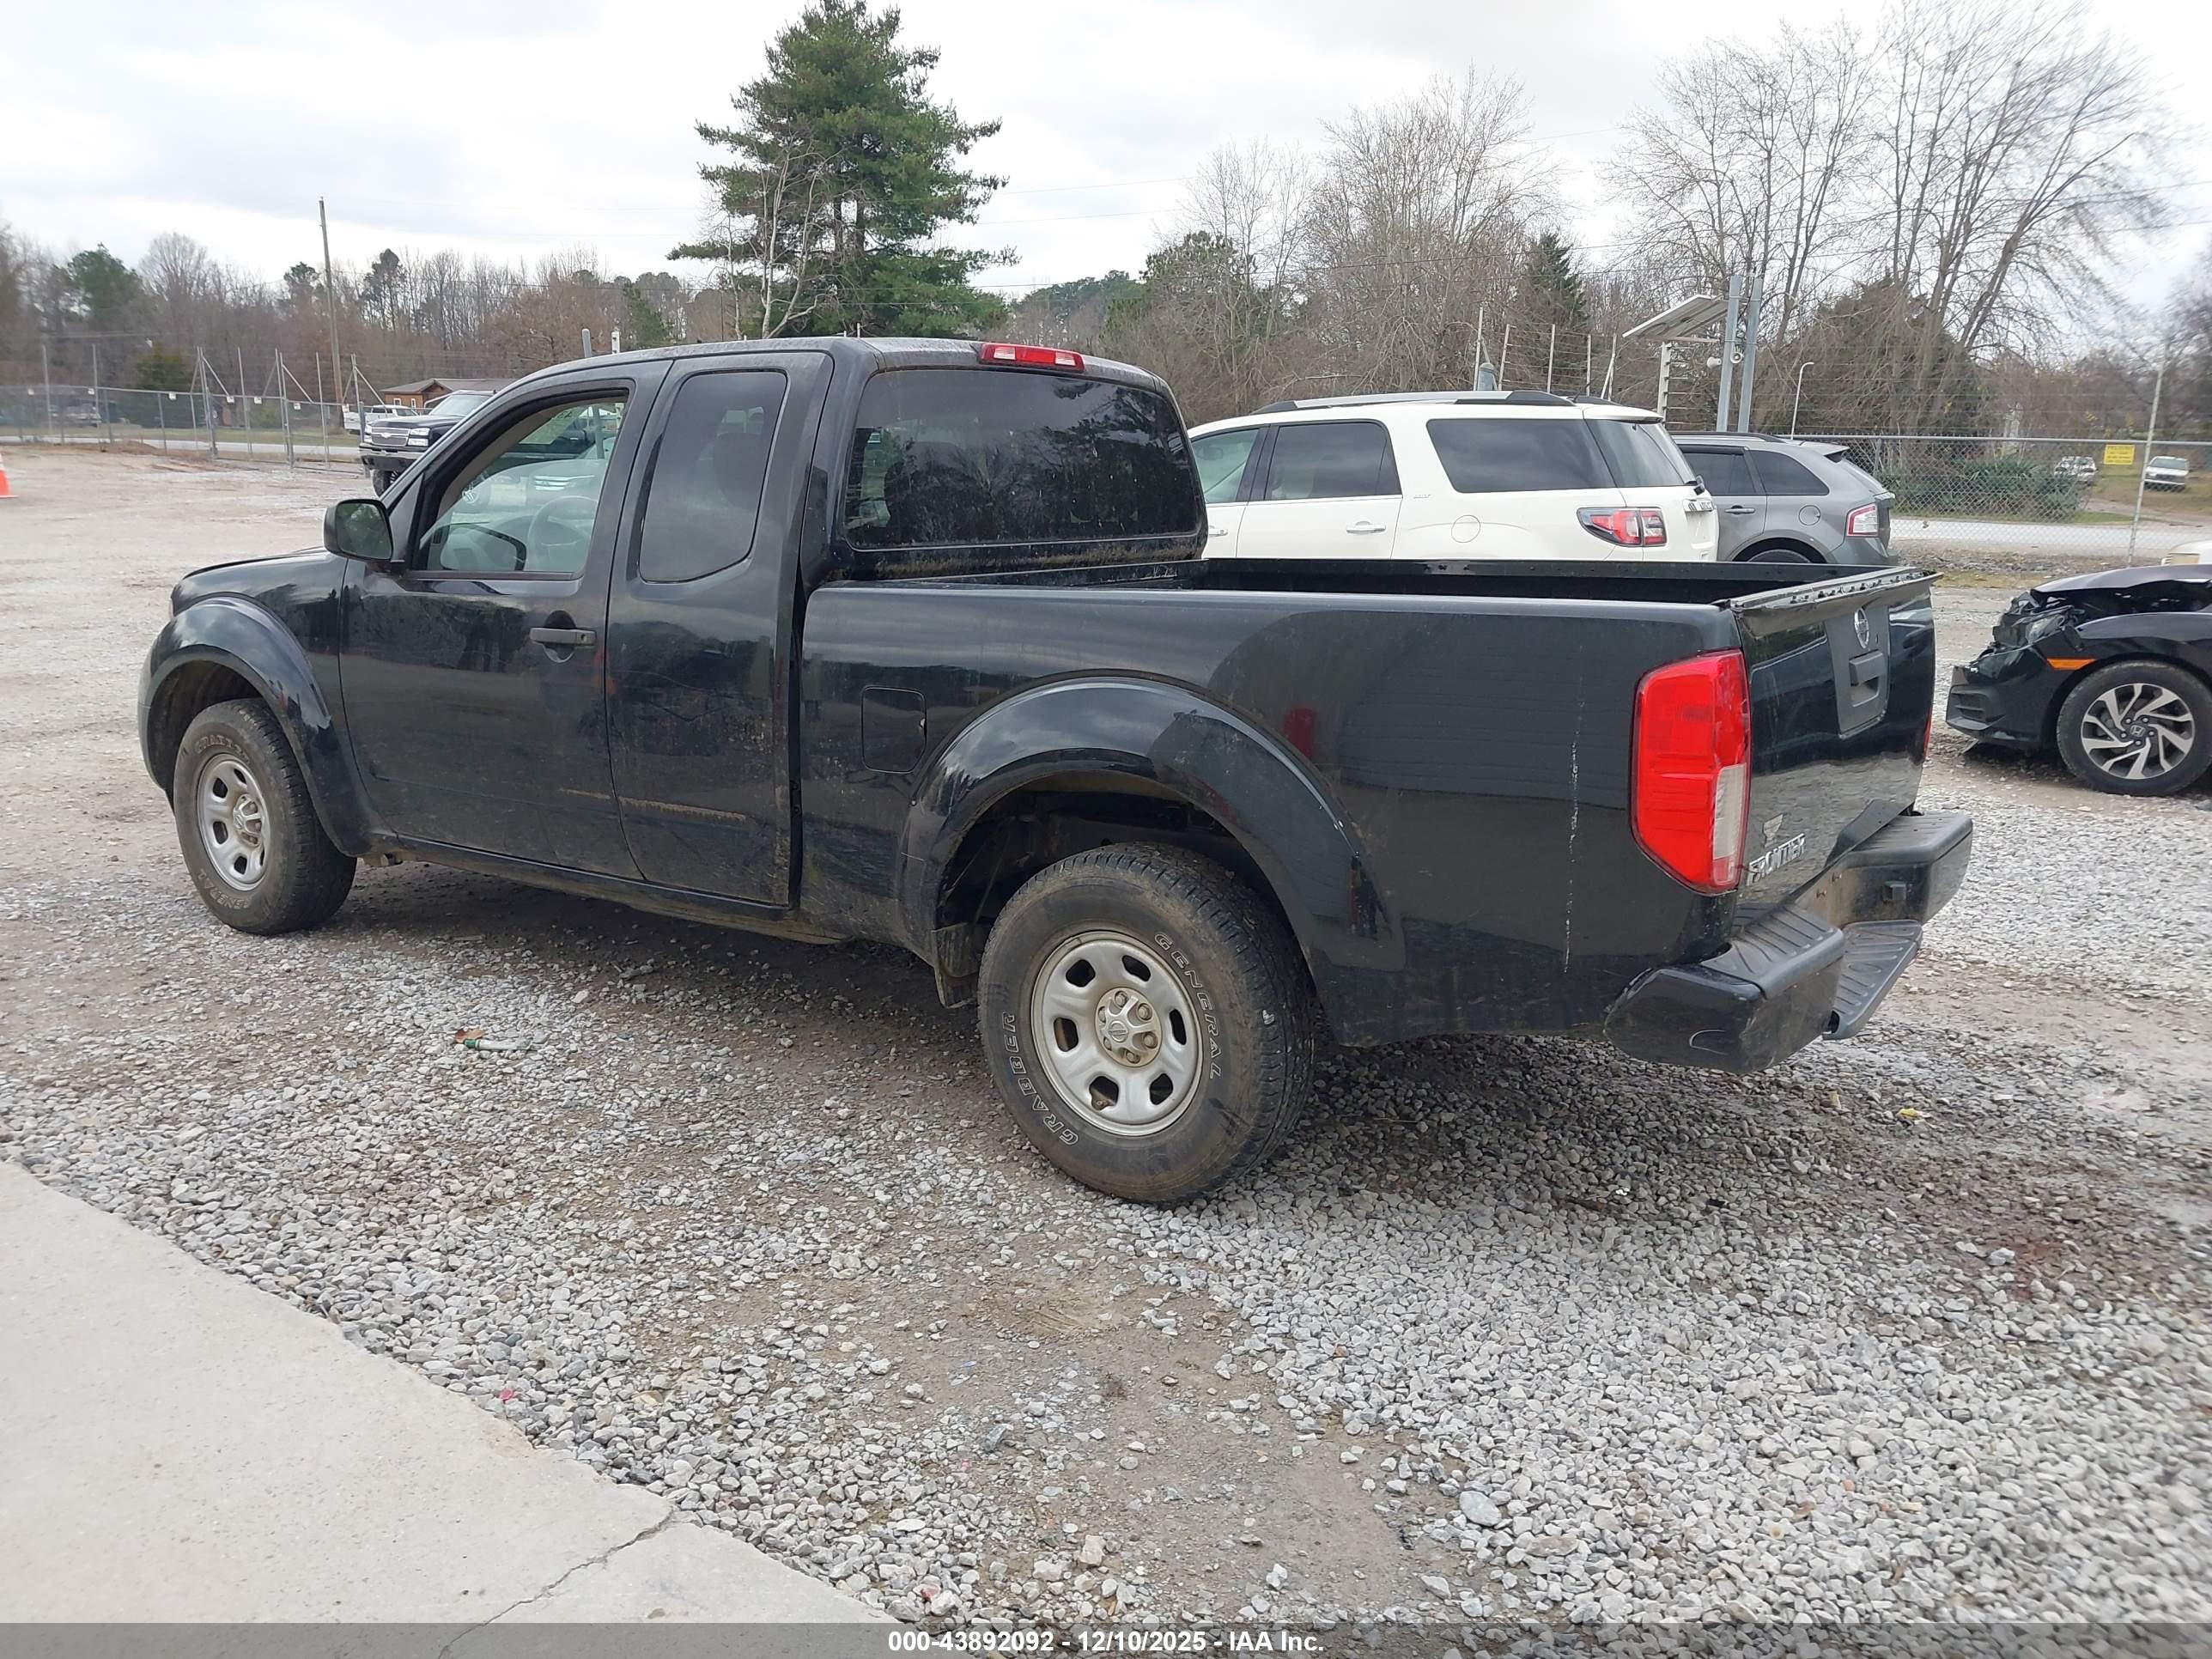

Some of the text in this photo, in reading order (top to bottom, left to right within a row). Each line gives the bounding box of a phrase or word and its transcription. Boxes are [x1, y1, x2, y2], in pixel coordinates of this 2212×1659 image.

[1747, 833, 1806, 886] FRONTIER
[1154, 933, 1223, 1079] GENERAL
[1002, 1011, 1079, 1146] GRABBER
